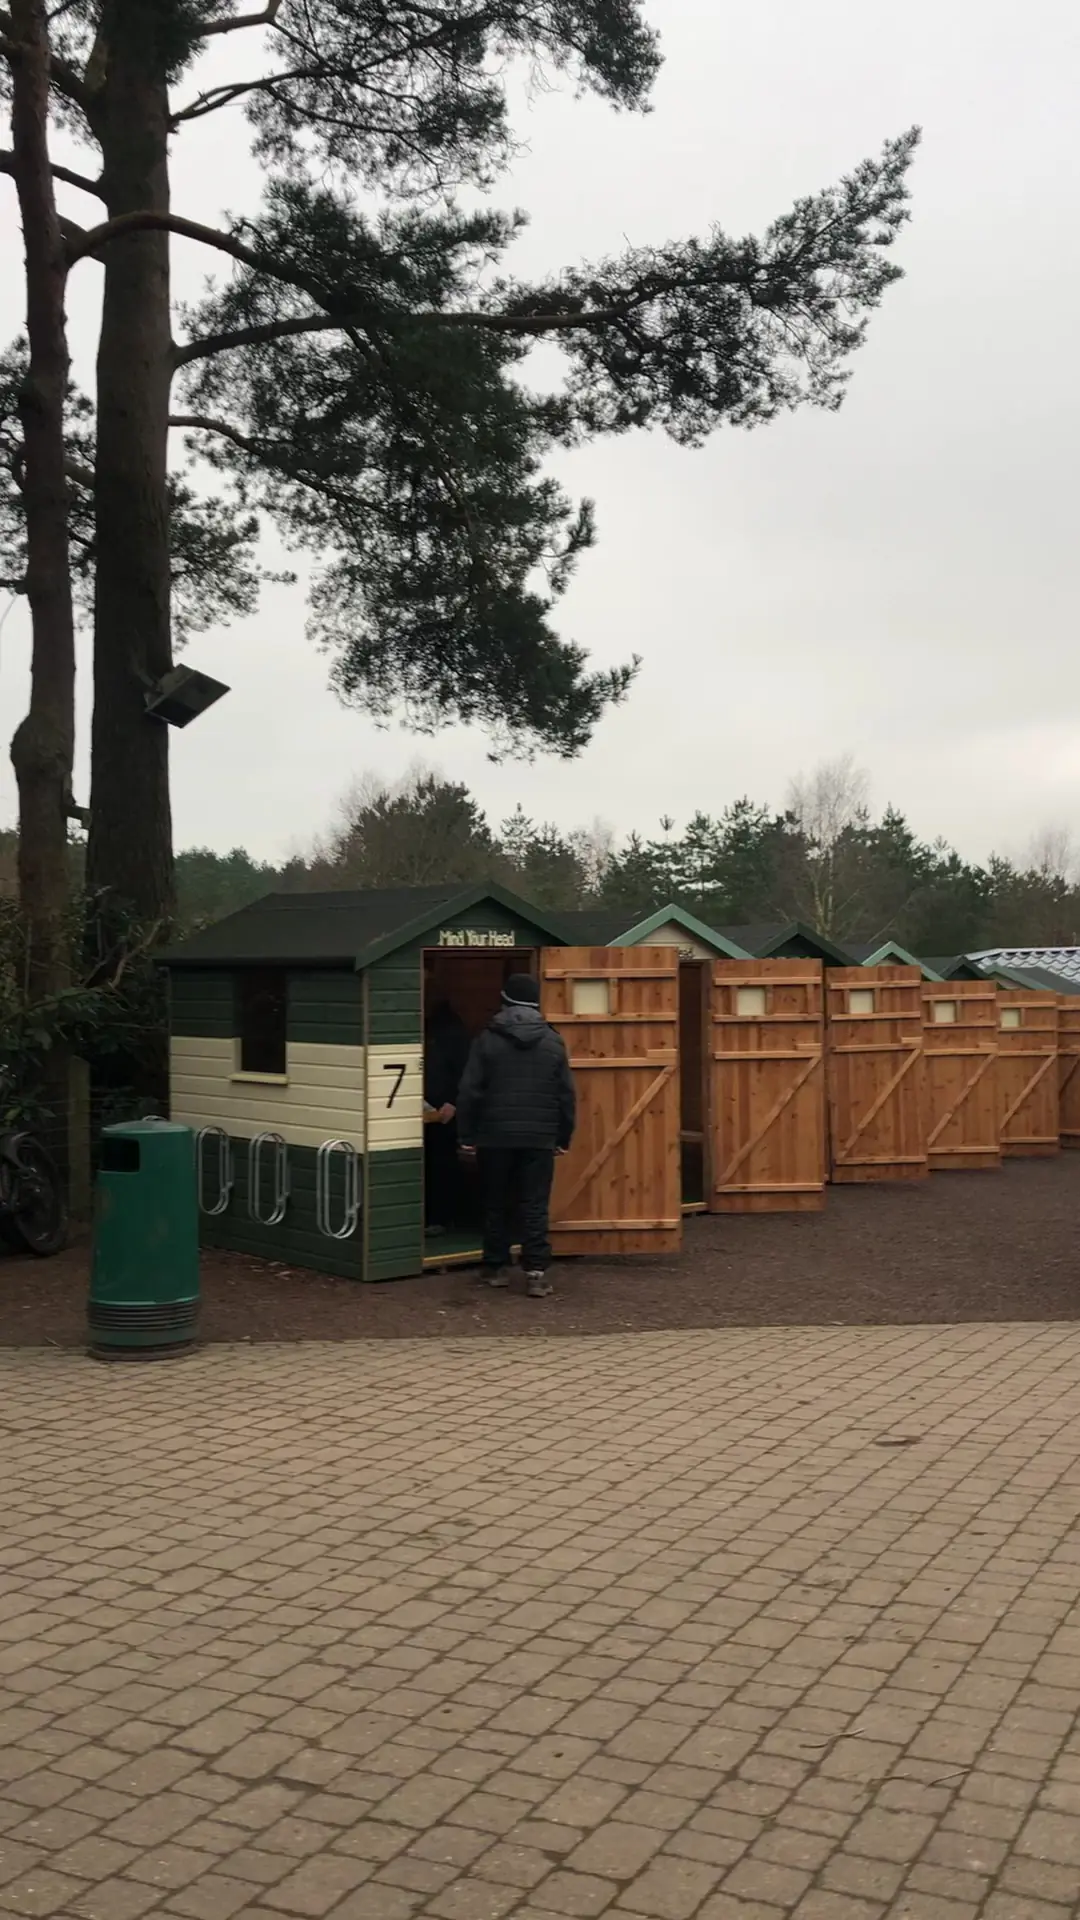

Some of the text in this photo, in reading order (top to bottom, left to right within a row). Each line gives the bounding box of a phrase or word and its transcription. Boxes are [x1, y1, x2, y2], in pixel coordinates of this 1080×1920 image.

[438, 929, 515, 946] Mind Your Head
[383, 1063, 407, 1109] 7
